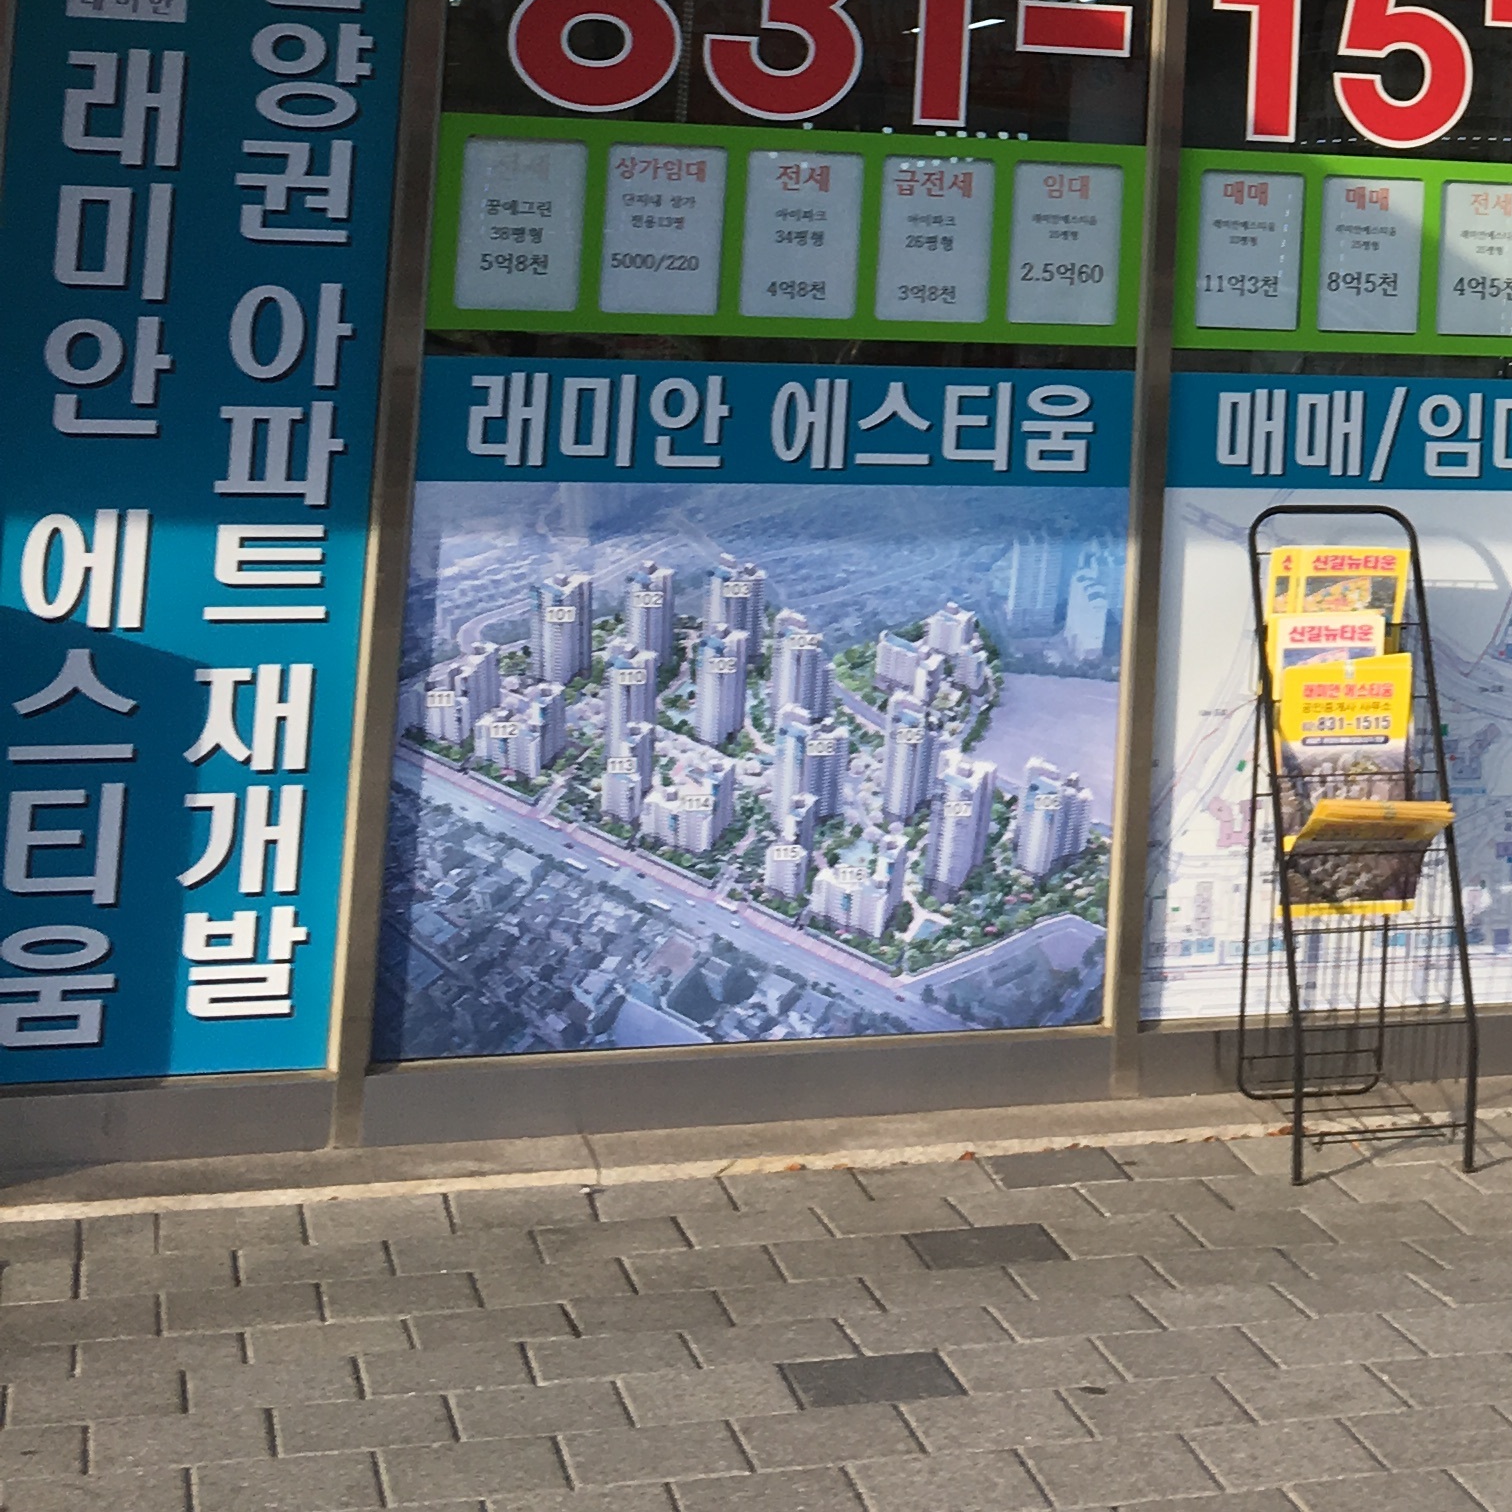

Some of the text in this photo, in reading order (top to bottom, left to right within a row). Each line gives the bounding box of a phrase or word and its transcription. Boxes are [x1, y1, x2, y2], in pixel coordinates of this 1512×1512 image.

[614, 157, 708, 183] 상가임대
[774, 164, 831, 193] 전세
[893, 169, 975, 199] 급전세
[1042, 173, 1091, 200] 임대
[1222, 180, 1270, 207] 매매
[484, 198, 553, 218] 꿈에그린
[1344, 186, 1390, 211] 매매
[774, 208, 828, 223] 아이파크
[774, 229, 826, 248] 34평형
[479, 253, 549, 276] 5억8천
[610, 252, 701, 272] 5000/220
[1019, 262, 1105, 286] 2.5억60
[1326, 271, 1399, 297] 8억5천
[765, 280, 827, 302] 4억8천
[897, 284, 958, 306] 3억8천
[1203, 273, 1279, 298] 11억3천
[465, 371, 1096, 473] 래미안 에스티움
[202, 282, 354, 624] 아파트
[0, 48, 188, 1048] 래미안 에스티움
[1311, 554, 1397, 572] 신길뉴타운
[634, 592, 663, 606] 102
[547, 608, 573, 620] 101
[1288, 624, 1375, 643] 신길뉴타운
[427, 691, 454, 706] 111
[491, 722, 520, 737] 112
[685, 796, 712, 810] 114
[175, 662, 318, 1020] 재개발
[774, 847, 801, 860] 115
